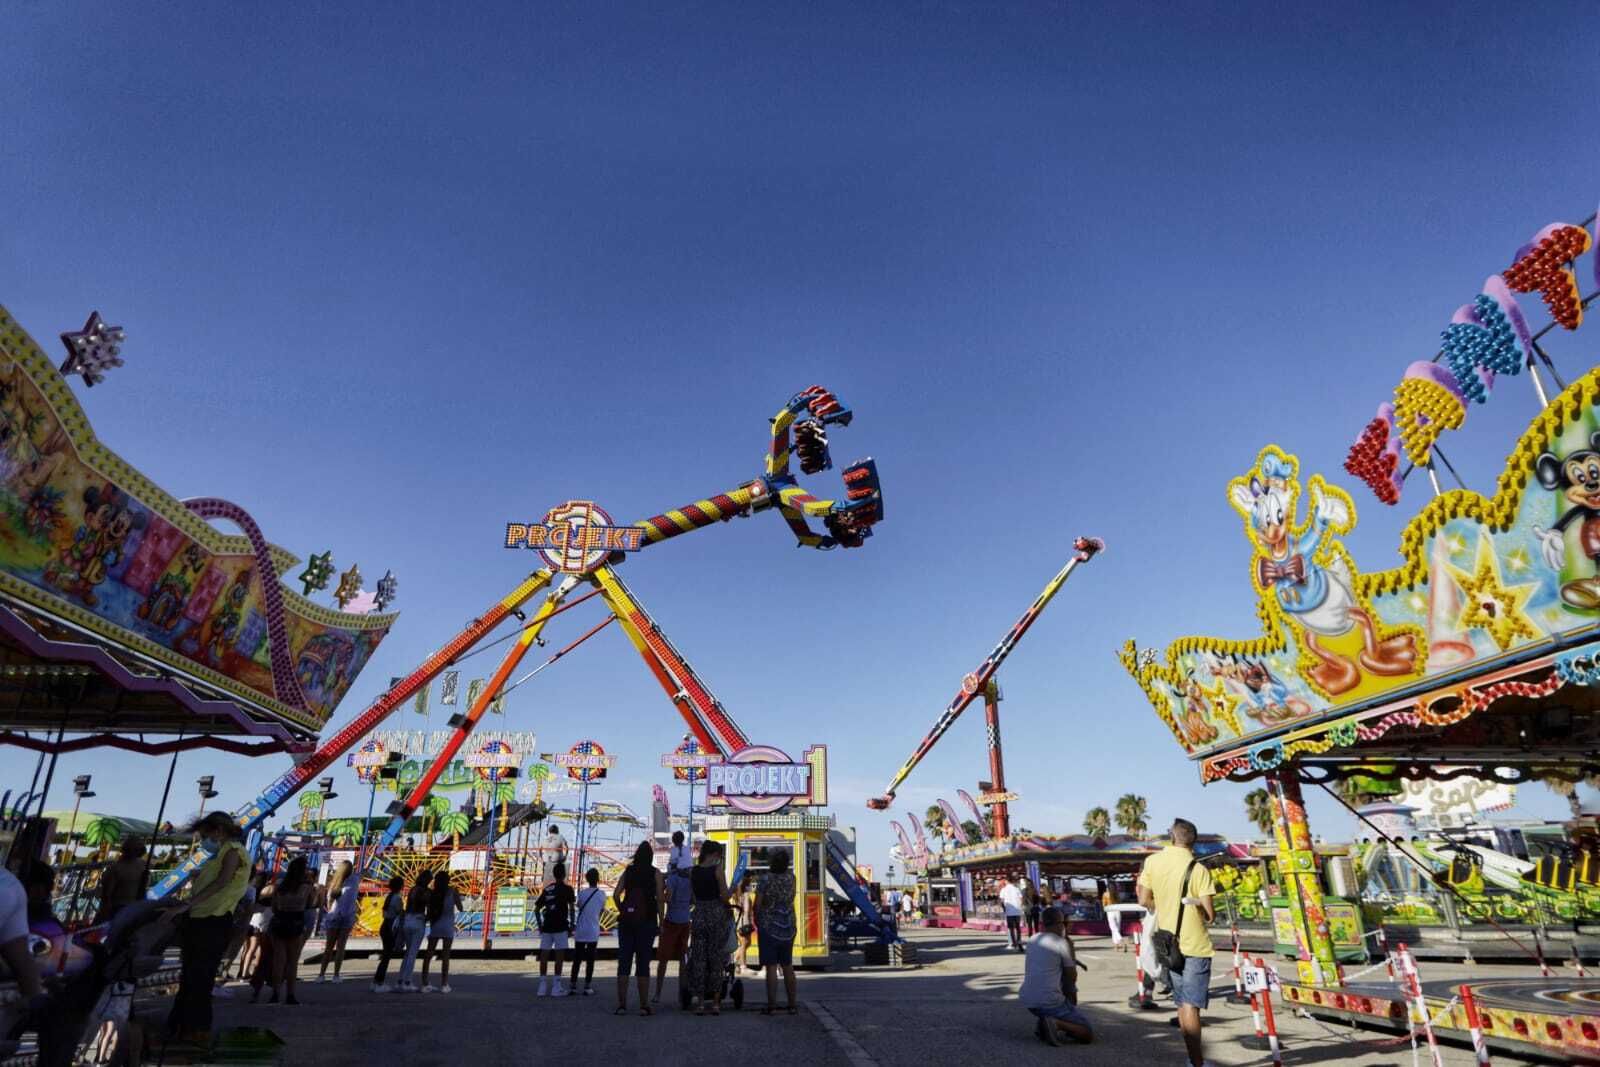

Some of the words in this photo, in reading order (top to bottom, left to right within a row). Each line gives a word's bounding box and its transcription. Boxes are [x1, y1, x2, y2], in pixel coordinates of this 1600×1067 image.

[1344, 205, 1600, 506] FANT
[506, 523, 645, 551] PROJEKT
[549, 500, 593, 574] 1
[709, 764, 811, 795] PROJEKT
[803, 744, 828, 806] 1
